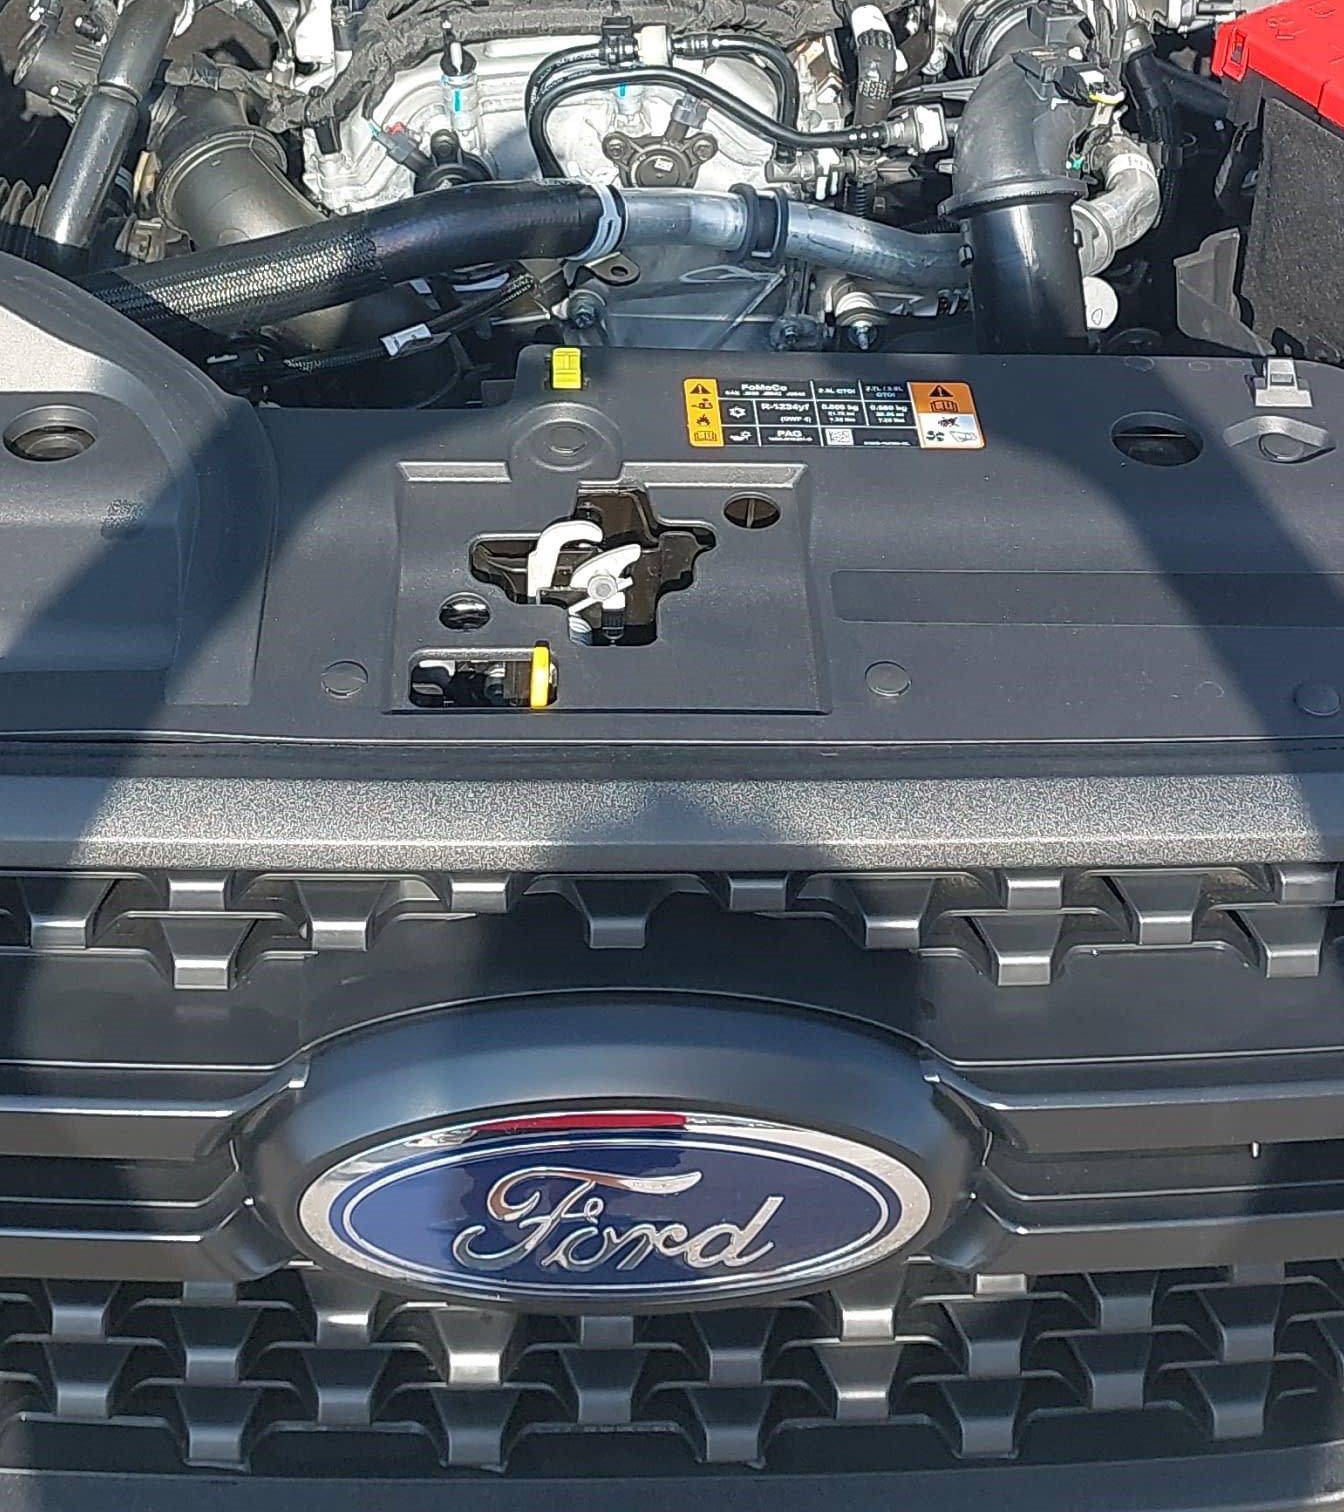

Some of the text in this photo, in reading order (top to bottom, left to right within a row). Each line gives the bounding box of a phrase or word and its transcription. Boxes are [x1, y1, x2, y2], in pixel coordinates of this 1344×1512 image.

[741, 383, 788, 392] FoMoCo
[760, 402, 810, 412] R-1234yf
[776, 429, 803, 437] PAG
[449, 1164, 785, 1272] Ford
